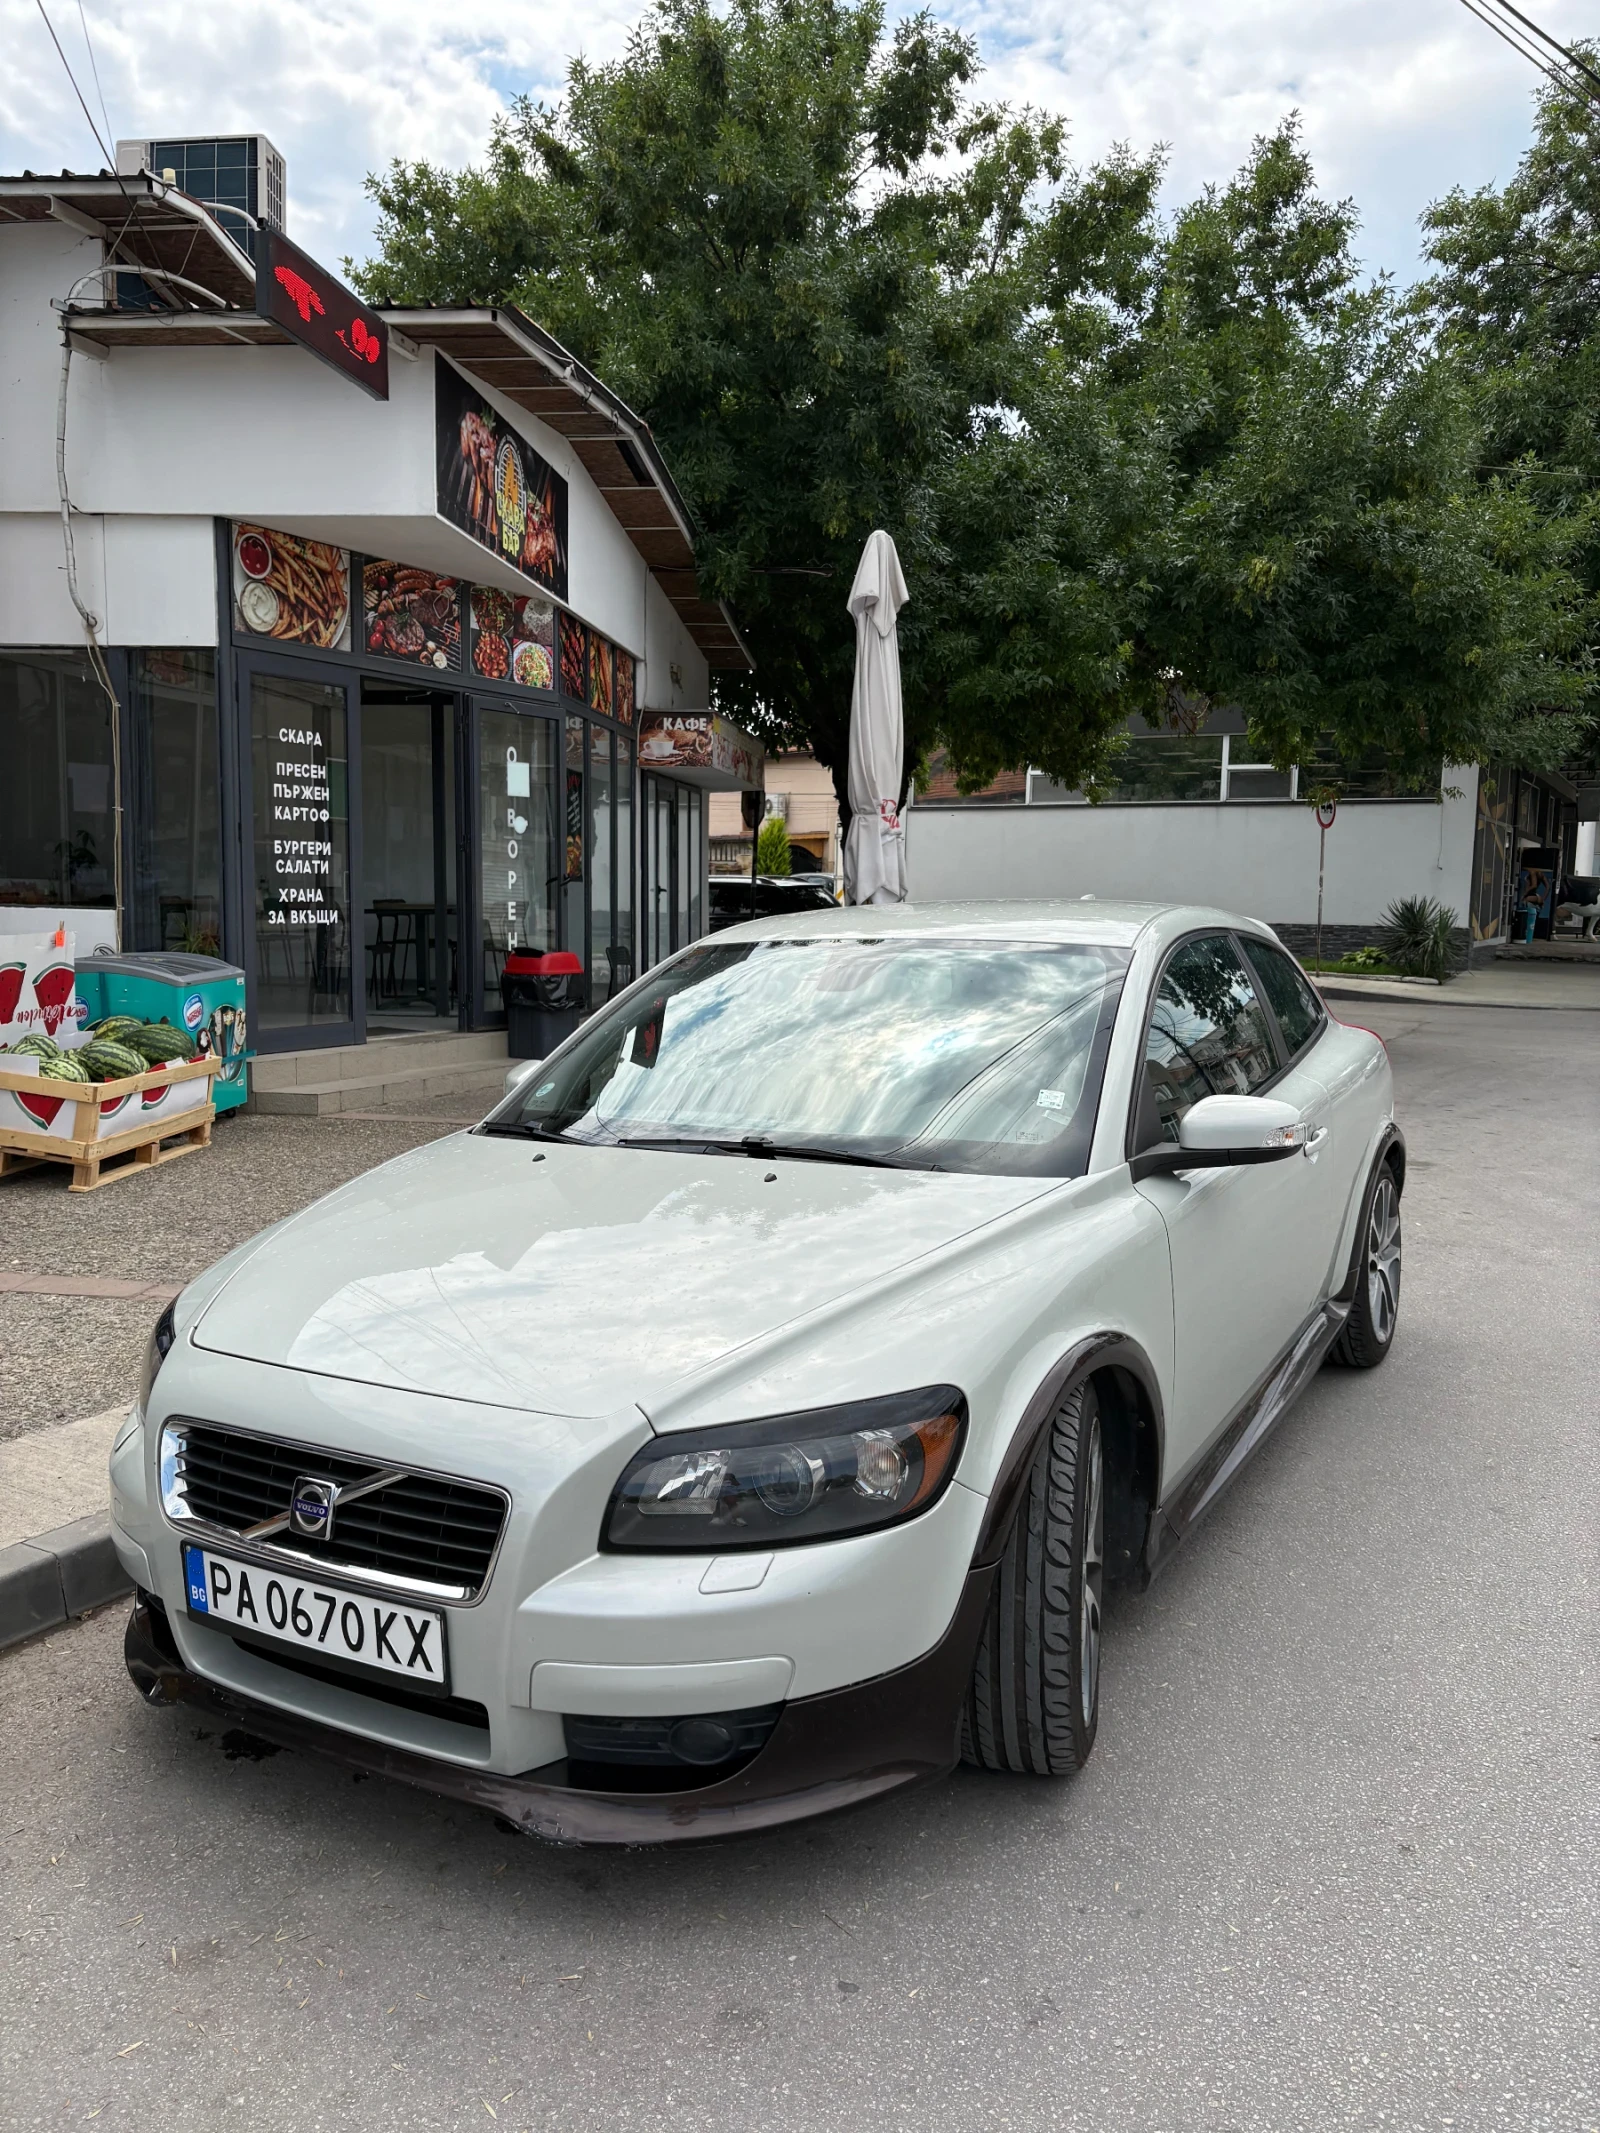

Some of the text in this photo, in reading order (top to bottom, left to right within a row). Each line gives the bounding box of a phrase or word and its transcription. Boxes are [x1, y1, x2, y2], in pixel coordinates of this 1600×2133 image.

[496, 490, 526, 536] СКАРА
[502, 522, 520, 556] БАР
[663, 717, 707, 732] КАФЕ
[279, 728, 322, 746] СКАРА
[276, 762, 326, 779] ПРЕСЕН
[273, 783, 330, 801] ПЪРЖЕН
[274, 805, 330, 822] КАРТОФ
[274, 840, 332, 856] БУРГЕРИ
[506, 746, 519, 951] ОВОРЕН
[275, 859, 329, 874] САЛАТИ
[278, 888, 324, 902] ХРАНА
[268, 910, 338, 925] ЗА ВКЪЩИ
[297, 1502, 326, 1515] VOLVO
[191, 1585, 206, 1603] BG
